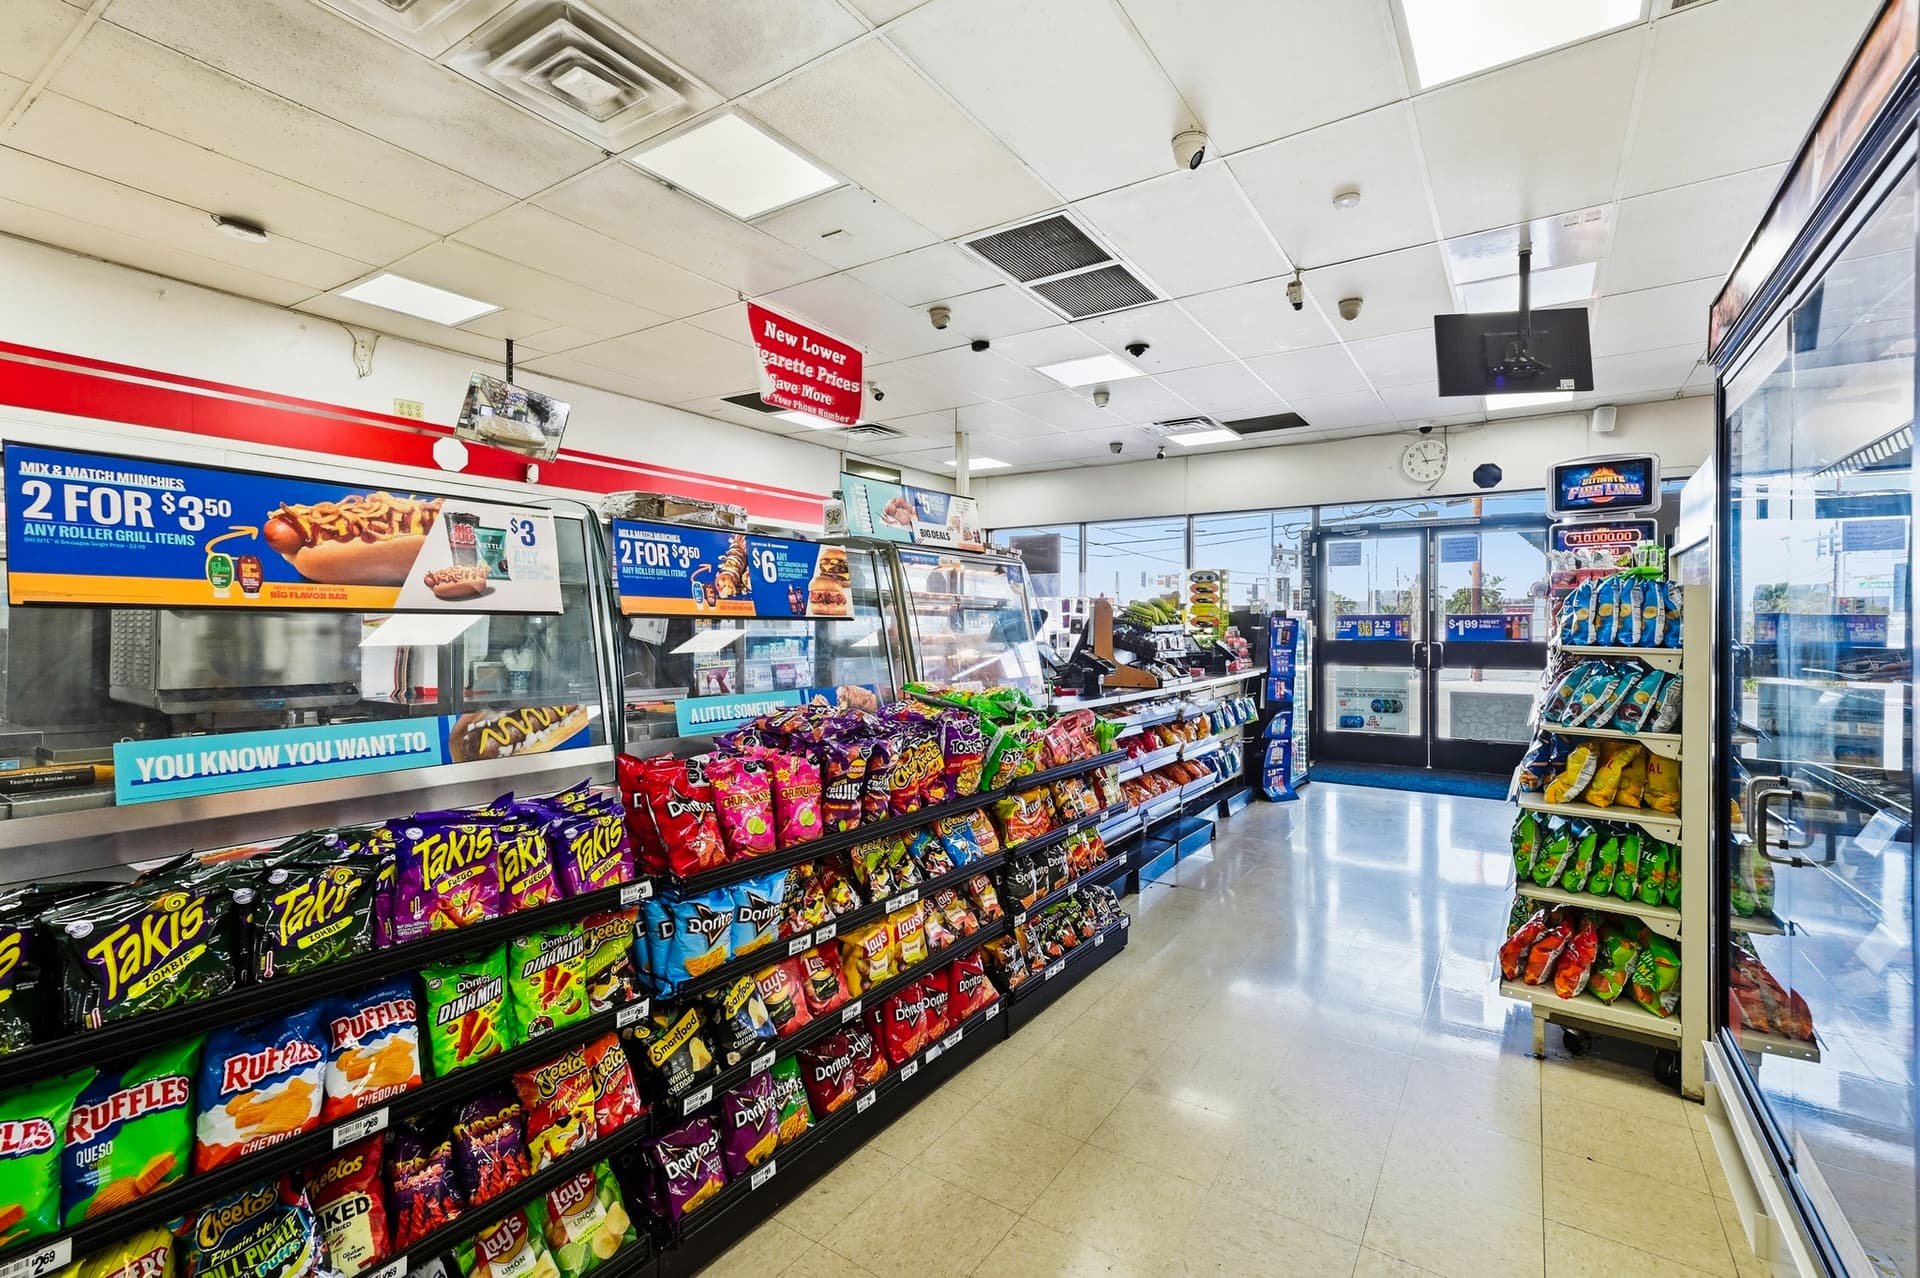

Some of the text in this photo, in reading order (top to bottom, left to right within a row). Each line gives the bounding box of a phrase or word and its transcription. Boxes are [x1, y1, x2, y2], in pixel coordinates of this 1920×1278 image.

[764, 320, 847, 365] New Lower
[758, 346, 860, 392] garette Prices
[773, 394, 792, 406] Your
[794, 400, 817, 414] Phone
[818, 407, 850, 423] Number
[801, 384, 833, 405] More
[20, 461, 184, 488] MIX & MATCH MUNCHIES
[21, 480, 53, 520] 2
[63, 483, 154, 528] FOR
[1568, 484, 1603, 500] FIRE
[24, 523, 195, 546] ANY ROLLER GRILL ITEMS
[510, 518, 536, 546] $3
[620, 540, 632, 564] 2
[634, 541, 670, 567] FOR
[752, 548, 777, 583] $6
[289, 591, 327, 600] FLAVOR
[328, 592, 348, 600] BAR
[691, 709, 700, 723] A
[700, 706, 733, 722] LITTLE
[136, 731, 427, 783] YOU KNOW YOU WANT TO
[412, 824, 493, 892] Takis
[571, 816, 623, 881] Takis
[447, 870, 474, 889] FUEGO
[522, 869, 549, 887] FUEGO
[308, 922, 342, 942] ZOMBIE
[897, 911, 924, 940] Lay's
[87, 893, 206, 1000] Takis
[522, 936, 585, 979] DINAMITA
[865, 930, 888, 957] Lay's
[143, 953, 190, 988] ZOMBIE
[757, 968, 787, 999] Lay's
[436, 976, 502, 1026] DINAMITA
[331, 999, 417, 1051] RUFFLES
[653, 1015, 698, 1062] Smartfood
[221, 1039, 322, 1095] RUFFLES
[668, 1068, 689, 1085] WHITE
[816, 1054, 850, 1081] Doritos
[357, 1084, 407, 1109] CHEDDAR
[668, 1075, 695, 1095] CHEDDAR
[65, 1074, 189, 1148] RUFFLES
[76, 1141, 113, 1168] QUESO
[665, 1139, 718, 1180] Doritos
[552, 1172, 590, 1214] Lay's
[198, 1187, 277, 1248] Cheetos
[257, 1218, 277, 1239] Hot
[246, 1215, 300, 1265] PICKLE
[479, 1216, 521, 1260] Lay's
